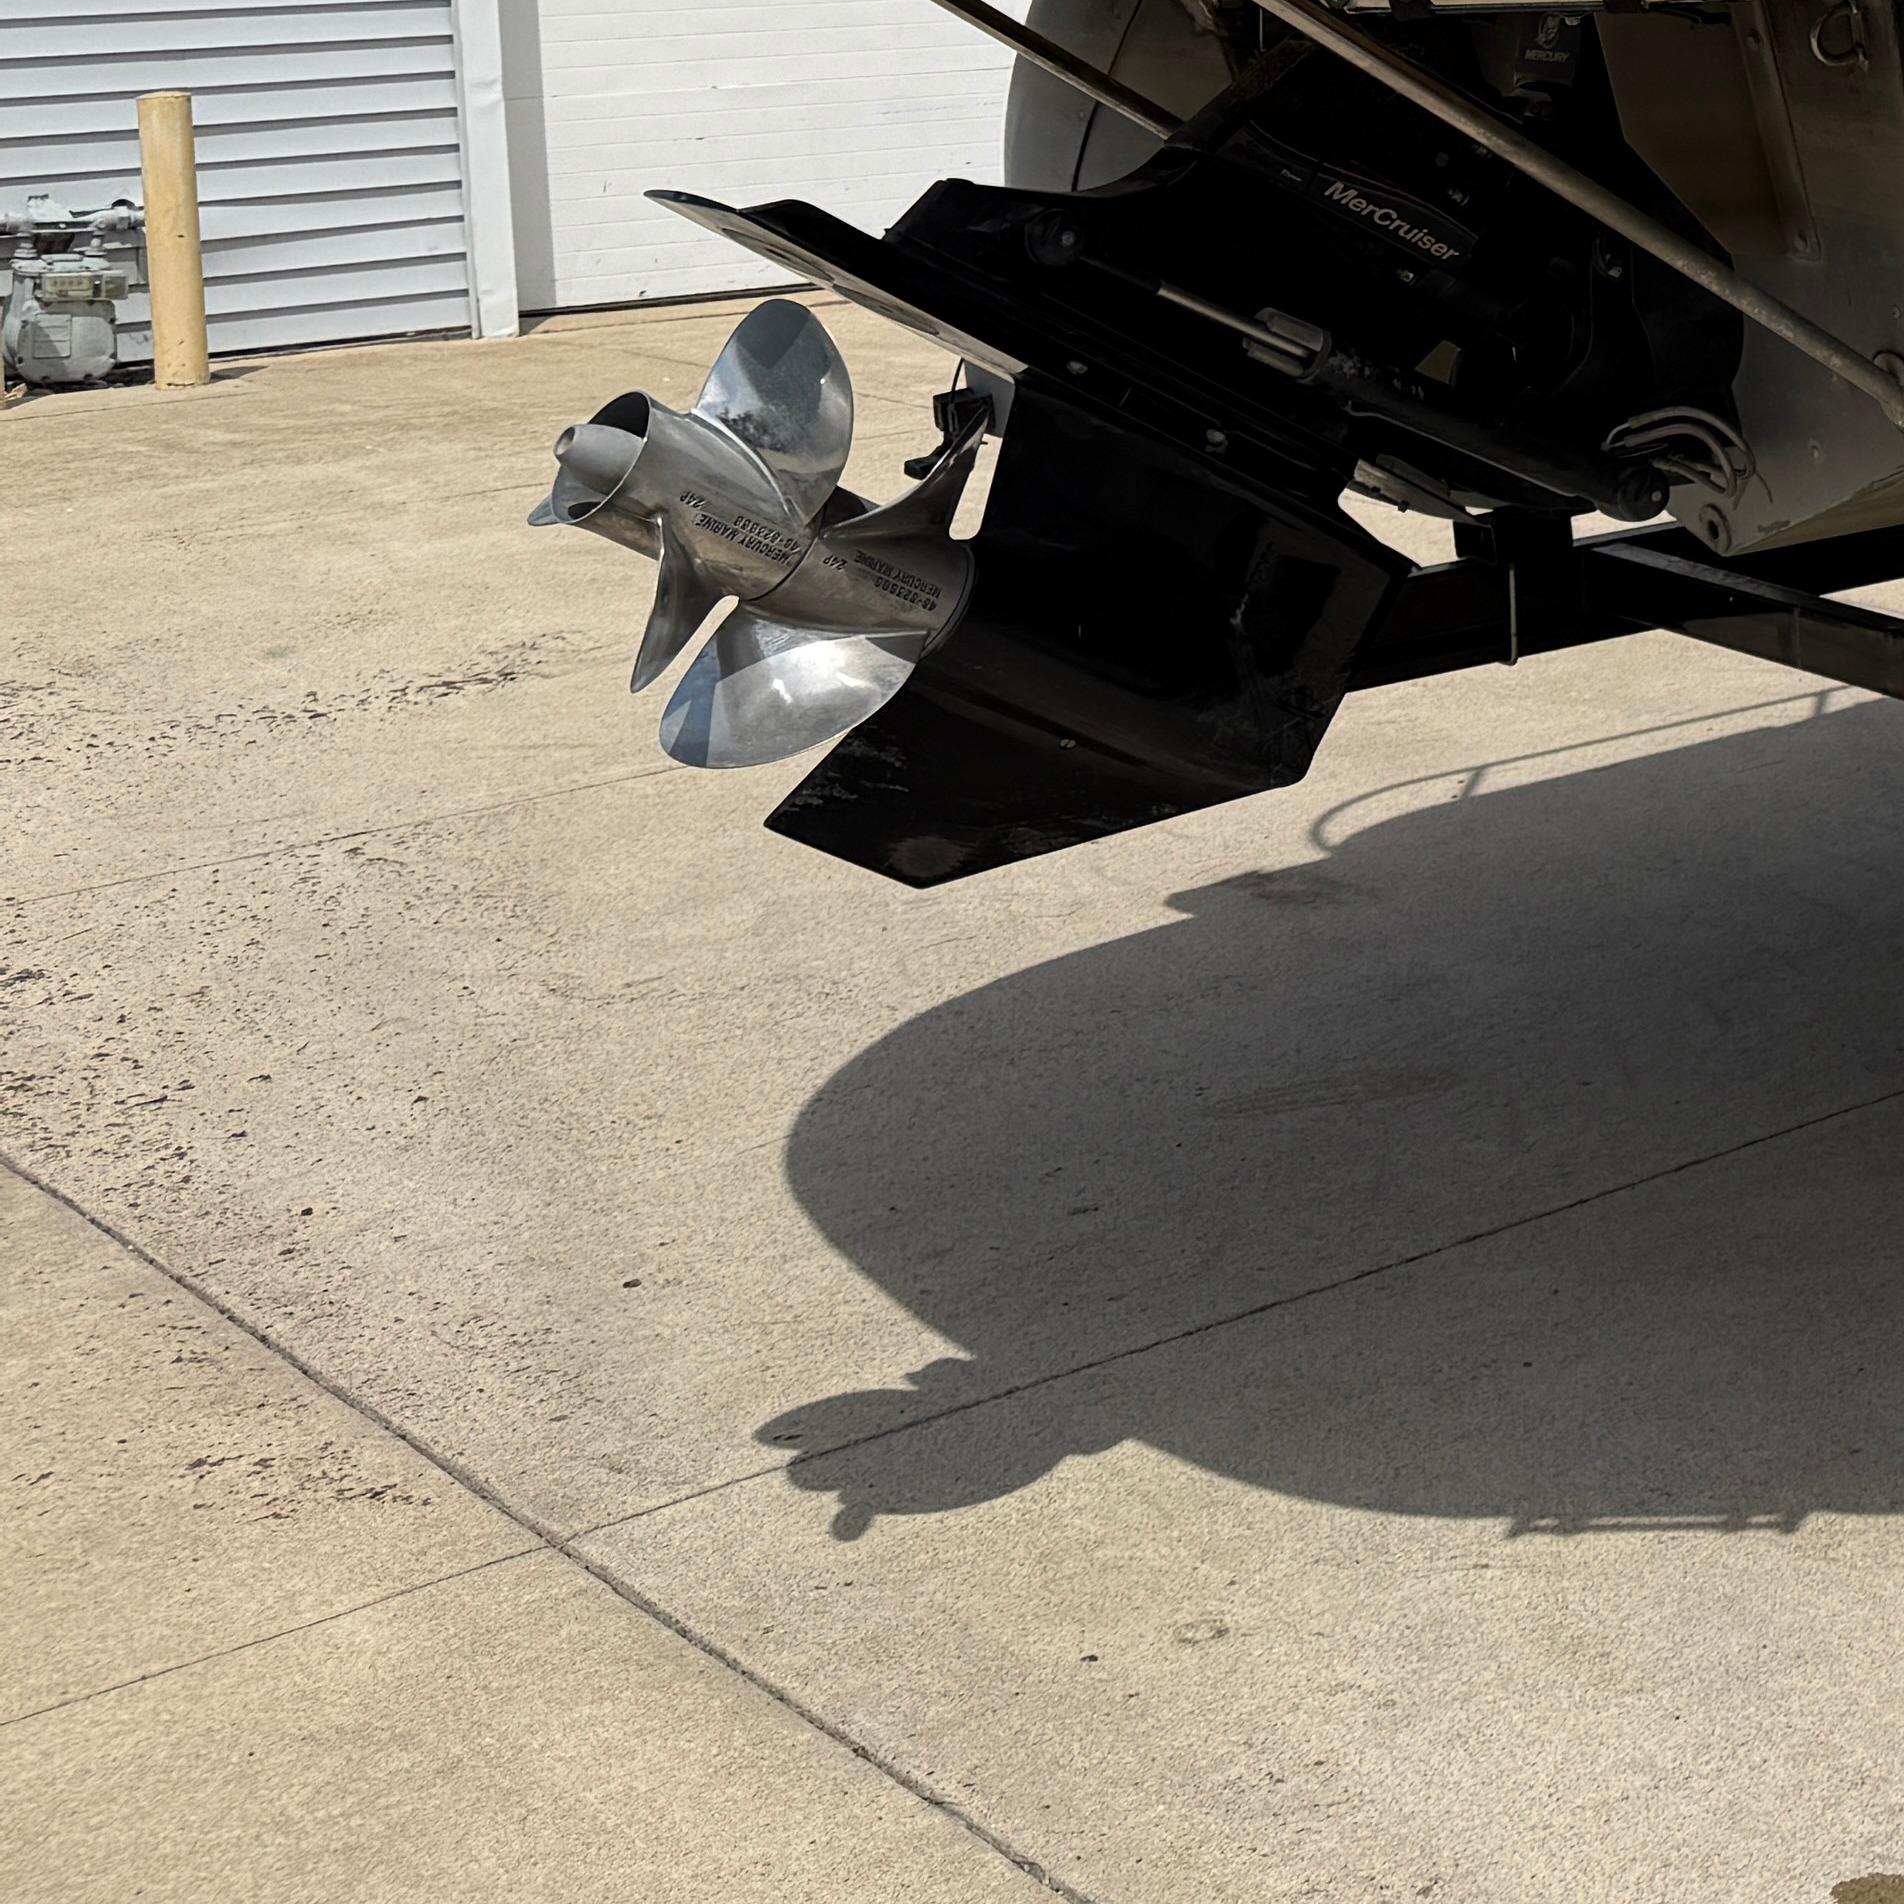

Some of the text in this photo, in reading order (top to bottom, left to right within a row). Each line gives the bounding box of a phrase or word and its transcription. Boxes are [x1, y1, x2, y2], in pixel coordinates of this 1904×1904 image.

[1524, 49, 1570, 63] MERCURY
[1323, 180, 1460, 261] MerCruiser
[738, 536, 793, 566] MERCURY
[893, 569, 942, 598] MERCURY
